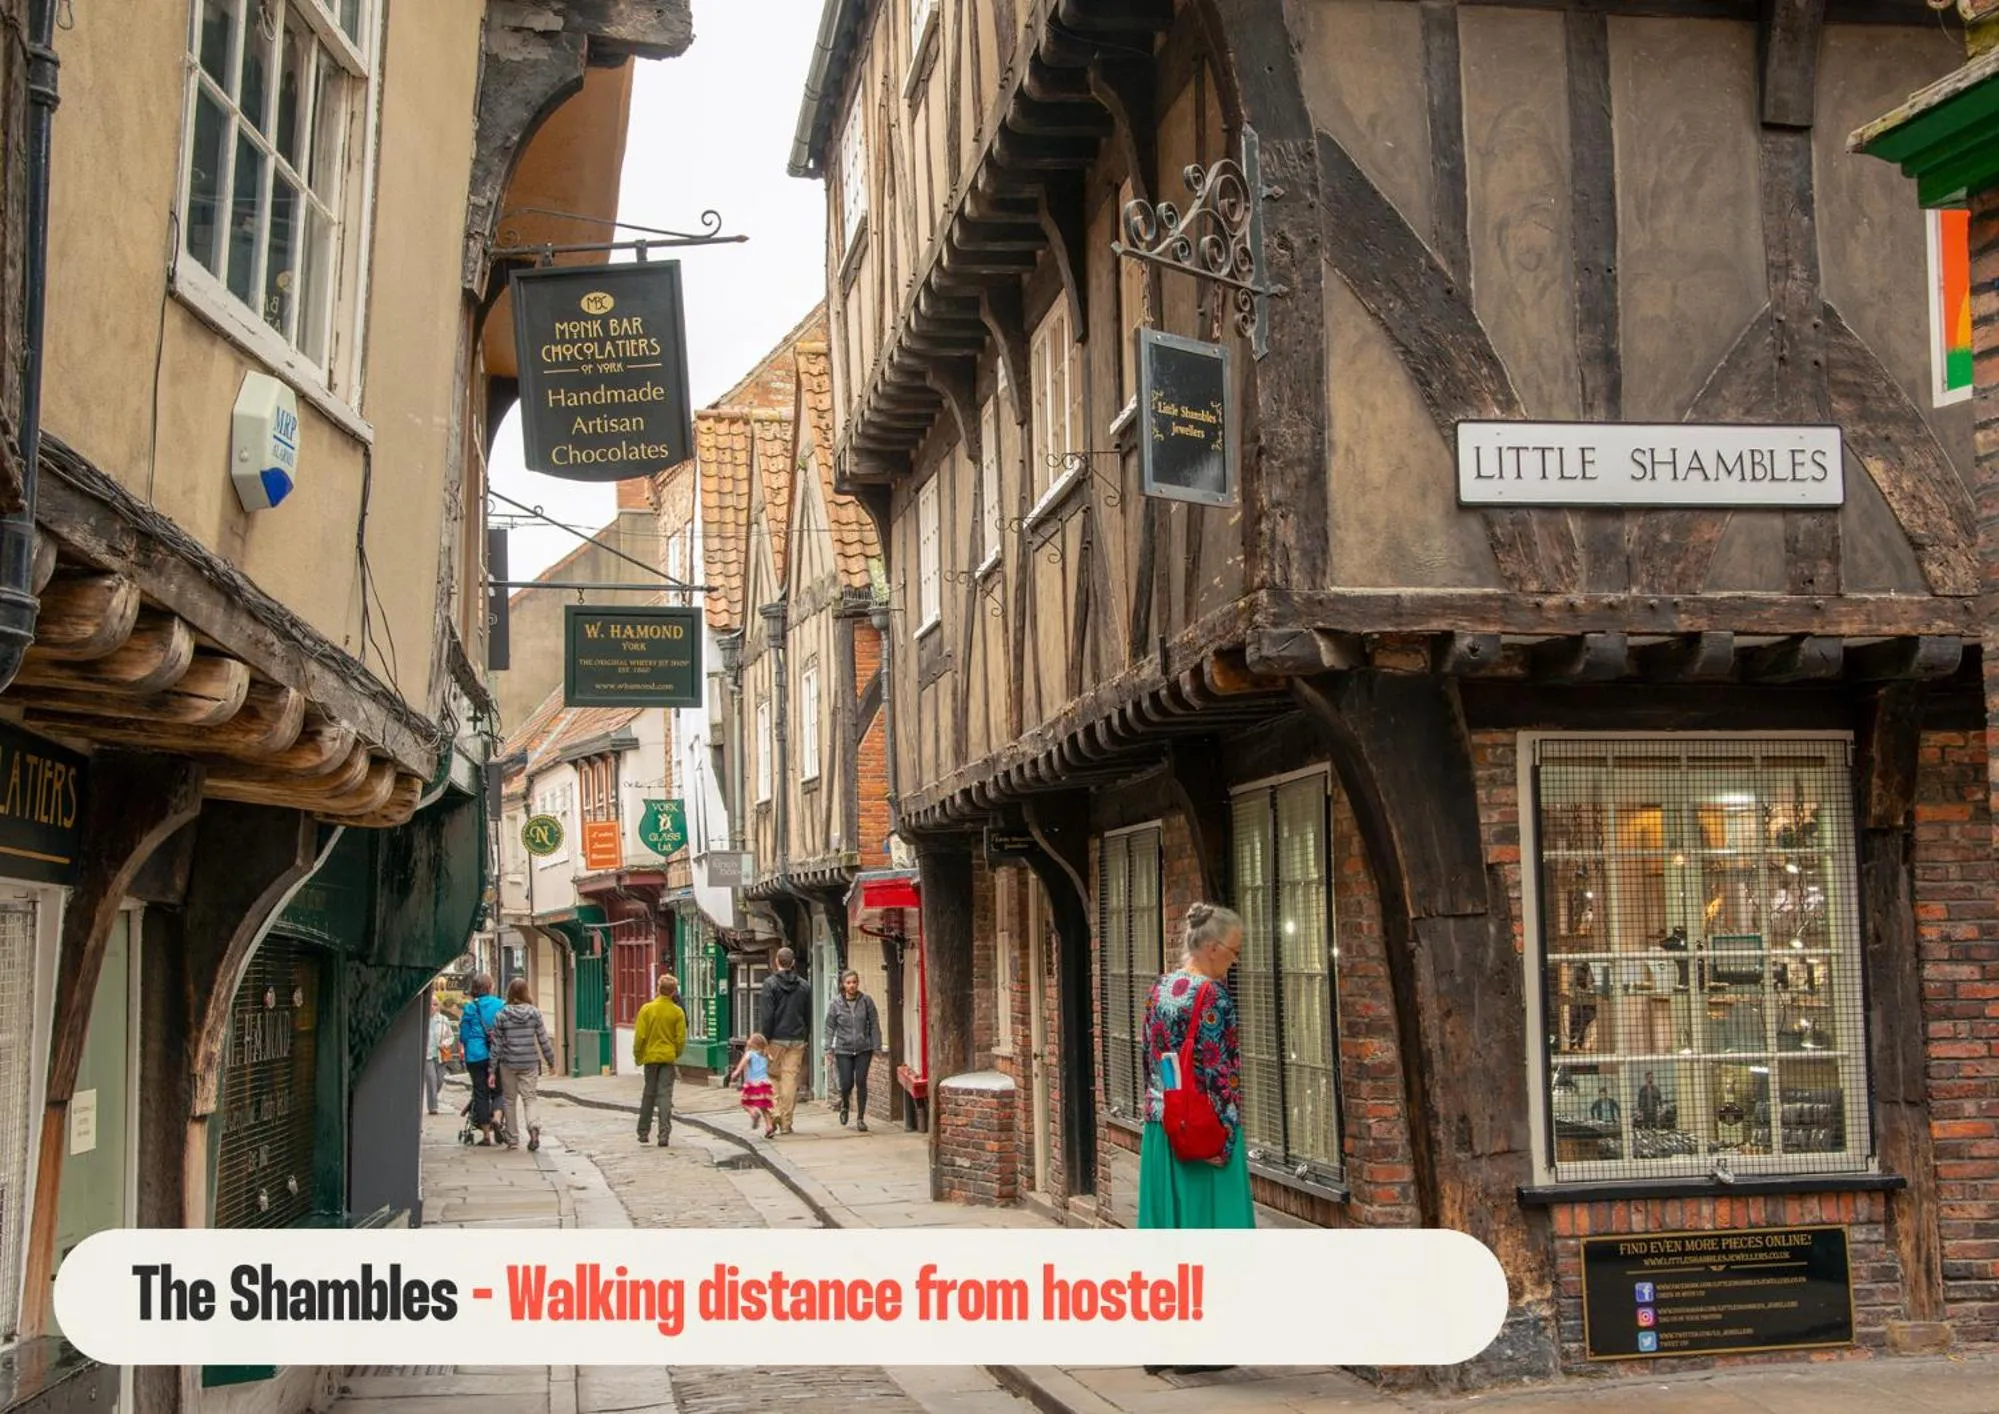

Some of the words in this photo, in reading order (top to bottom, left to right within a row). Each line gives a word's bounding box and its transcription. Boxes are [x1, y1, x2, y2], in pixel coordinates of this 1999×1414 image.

[555, 319, 602, 340] MONK
[609, 317, 643, 336] BAR
[541, 338, 661, 362] CHOCOLATIERS
[597, 362, 624, 374] YORK
[548, 381, 665, 408] Handmade
[571, 414, 645, 436] Artisan
[551, 441, 669, 465] Chocolates
[1474, 446, 1598, 481] LITTLE
[1630, 447, 1828, 482] SHAMBLES
[584, 621, 605, 639] W.
[610, 624, 683, 639] HAMOND
[621, 641, 646, 651] YORK
[1619, 1241, 1647, 1256] FIND
[1650, 1239, 1682, 1254] EVEN
[1685, 1238, 1719, 1252] MORE
[1721, 1236, 1763, 1250] PIECES
[1765, 1233, 1812, 1248] ONLINE!
